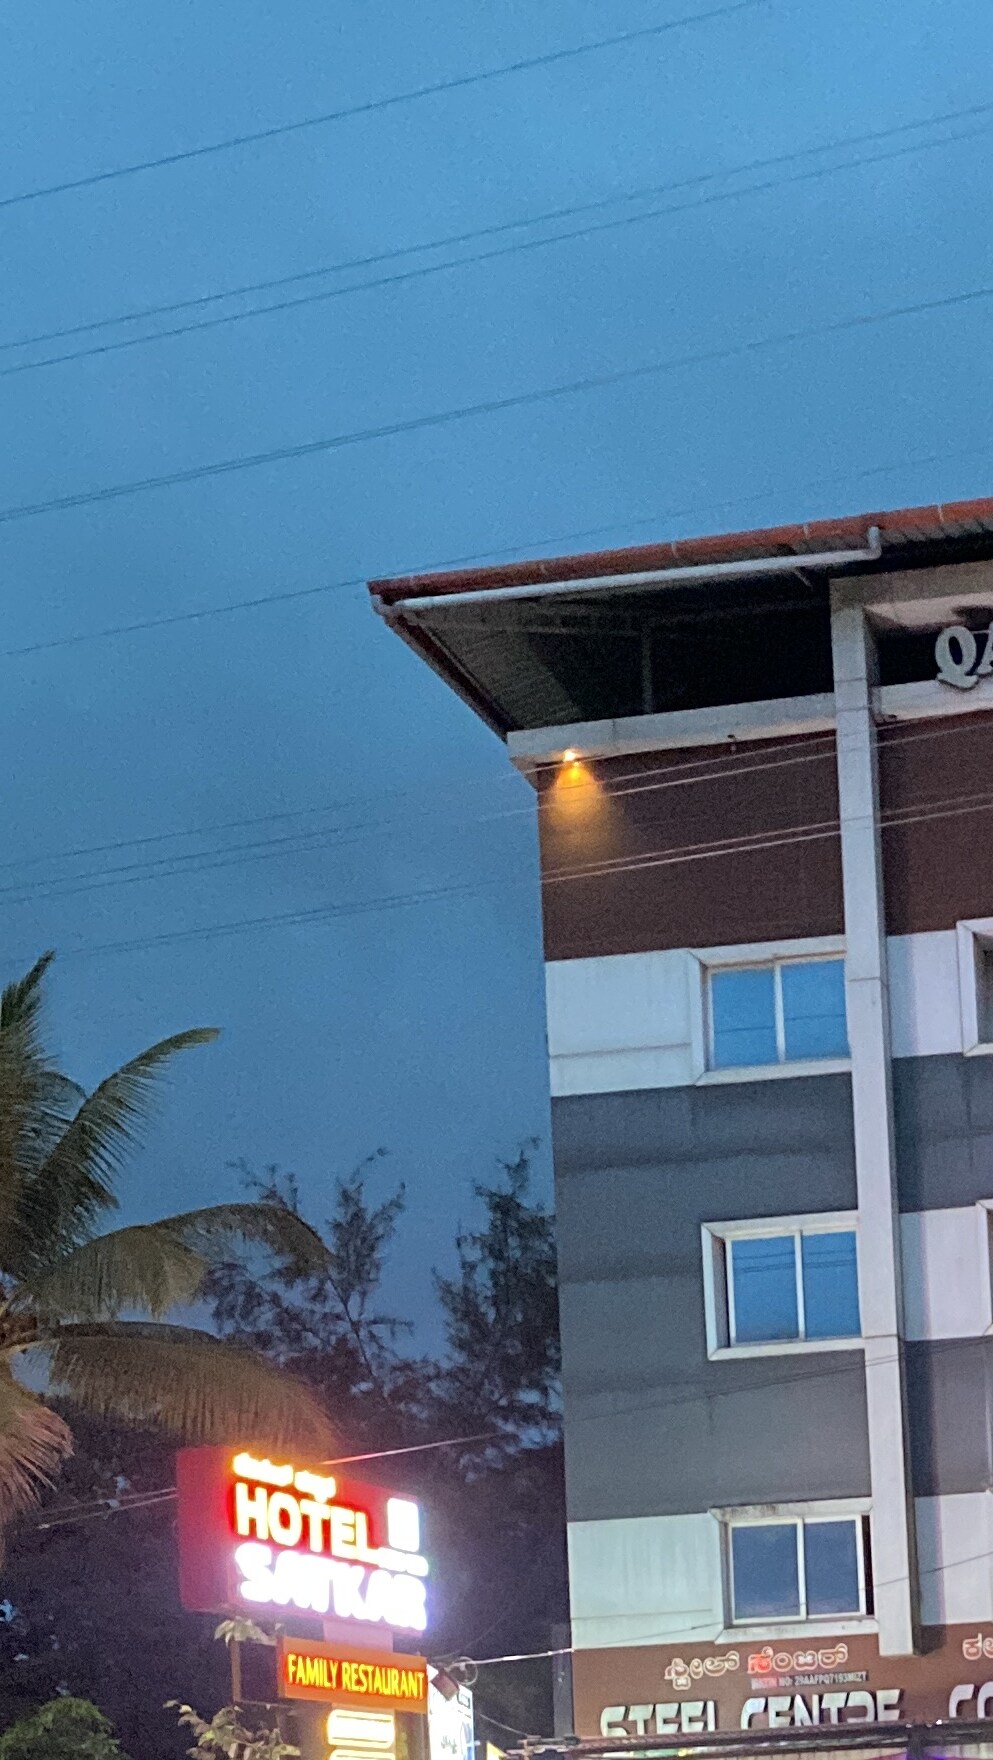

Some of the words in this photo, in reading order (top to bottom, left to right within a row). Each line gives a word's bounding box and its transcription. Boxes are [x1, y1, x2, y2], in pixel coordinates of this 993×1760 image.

[234, 1482, 379, 1563] HOTEL
[287, 1653, 338, 1690] FAMILY
[341, 1661, 425, 1700] RESTAURANT
[600, 1701, 716, 1738] STEEL
